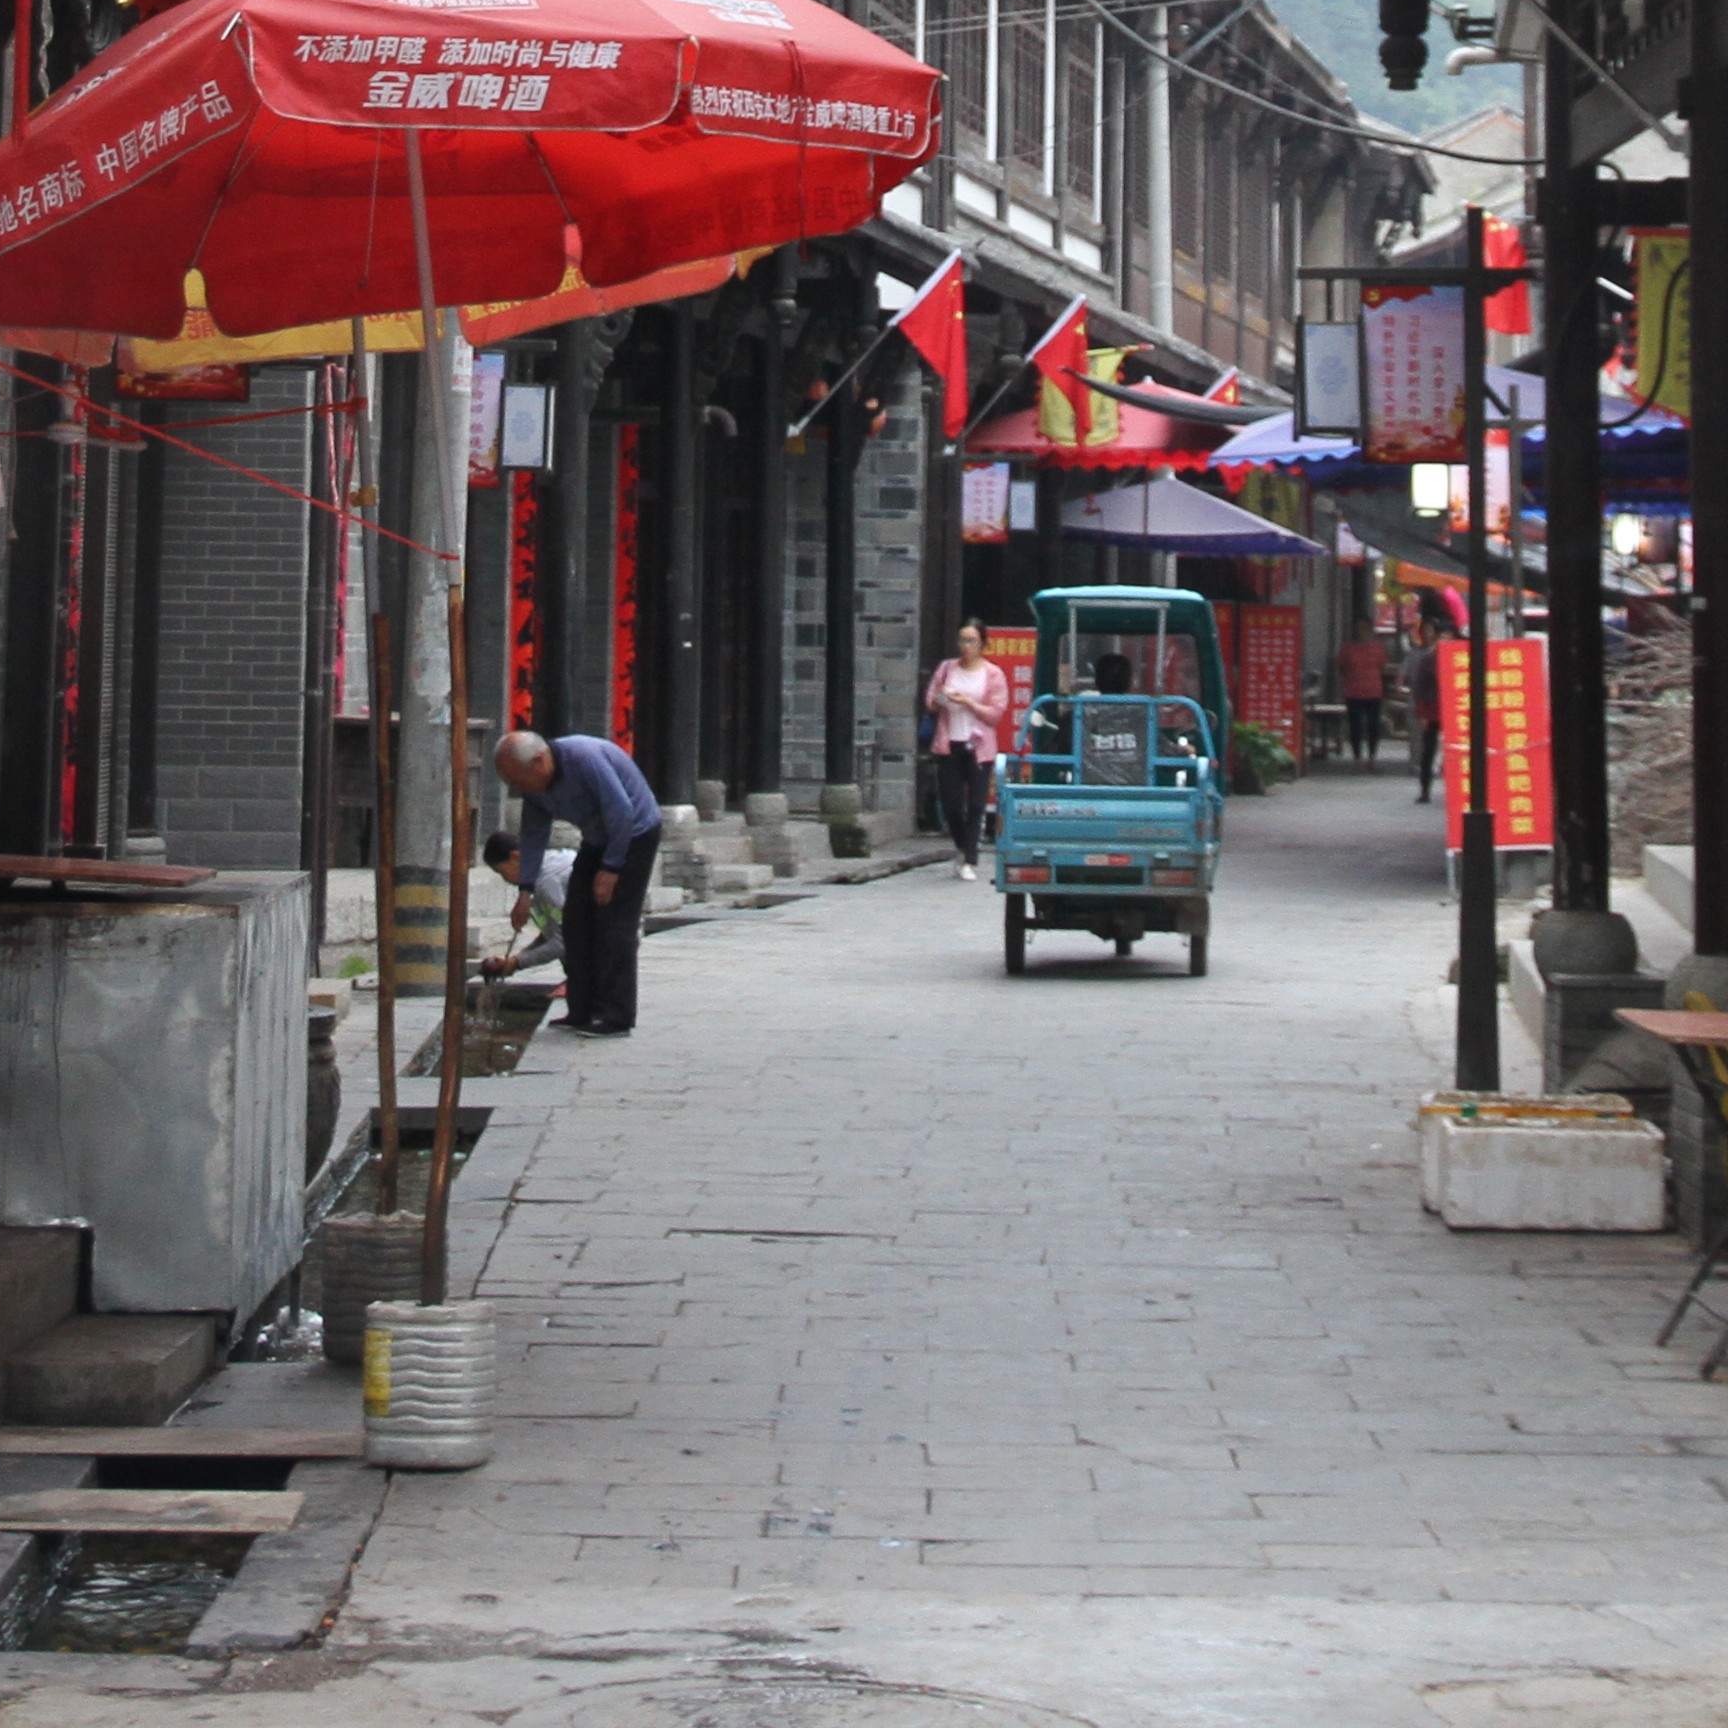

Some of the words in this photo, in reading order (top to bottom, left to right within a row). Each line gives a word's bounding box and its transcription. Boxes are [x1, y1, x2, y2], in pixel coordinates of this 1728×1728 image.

[293, 34, 428, 65] 不添加甲醛
[437, 37, 622, 69] 添加时尚与健康
[362, 70, 551, 111] 金威啤酒
[95, 79, 234, 182] 中国名牌产品
